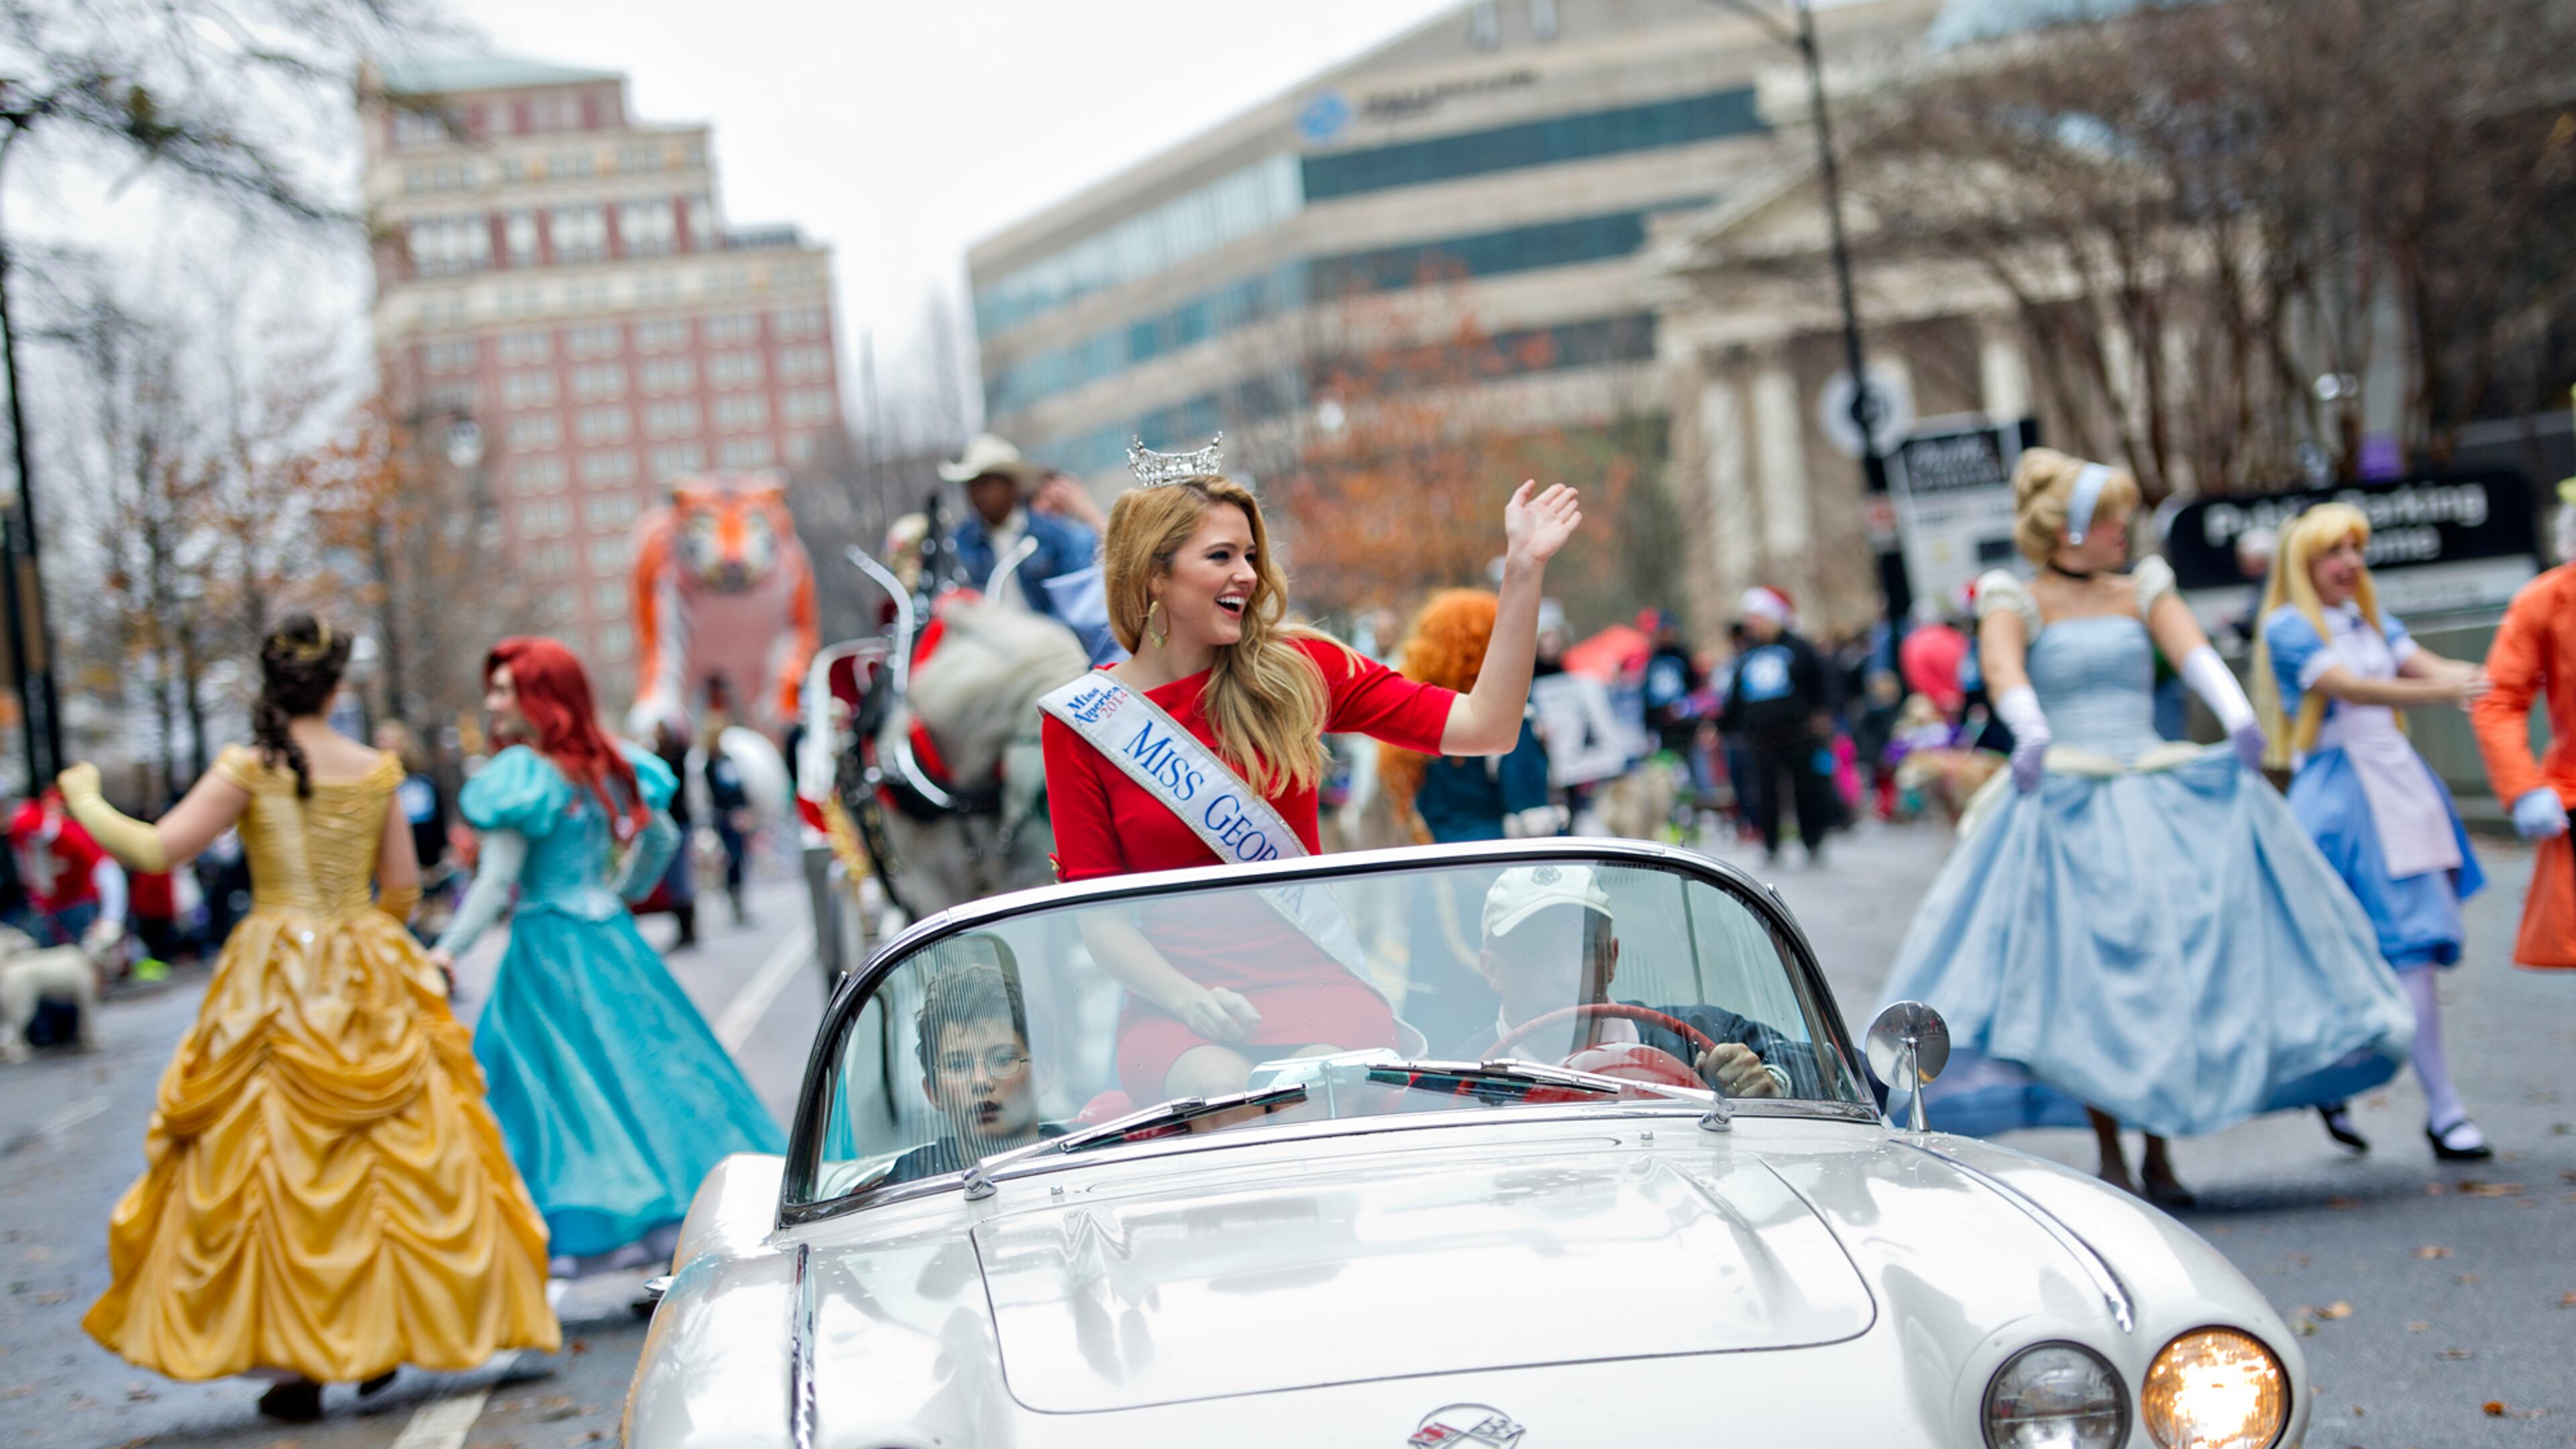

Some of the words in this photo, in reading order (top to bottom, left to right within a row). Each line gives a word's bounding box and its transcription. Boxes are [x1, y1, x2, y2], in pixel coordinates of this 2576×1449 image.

[1067, 688, 1100, 710] Miss
[1073, 686, 1120, 726] America
[1100, 690, 1129, 718] 2014
[1122, 718, 1204, 801] MISS
